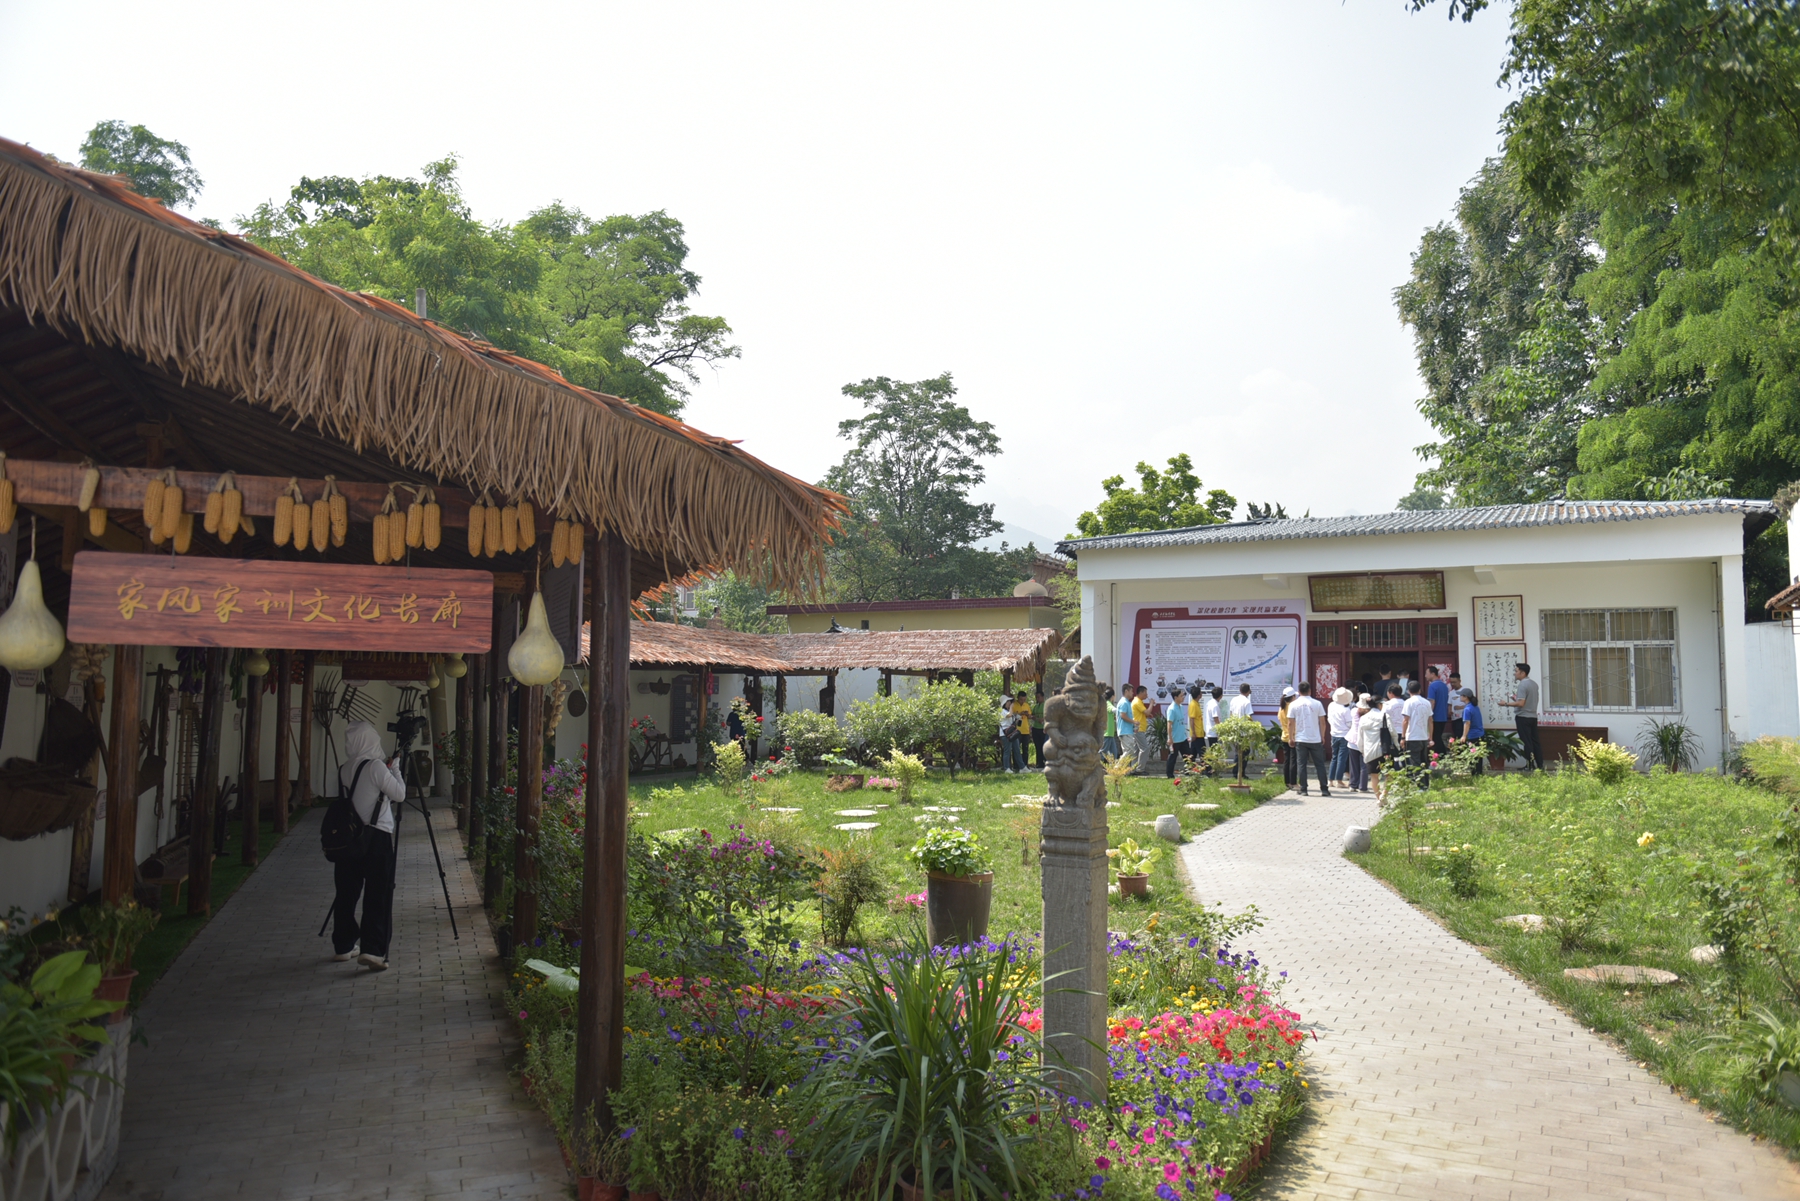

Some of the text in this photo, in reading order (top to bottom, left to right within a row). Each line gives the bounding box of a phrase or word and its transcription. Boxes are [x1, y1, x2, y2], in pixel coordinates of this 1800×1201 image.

[116, 577, 463, 629] 家风家训文化长廊
